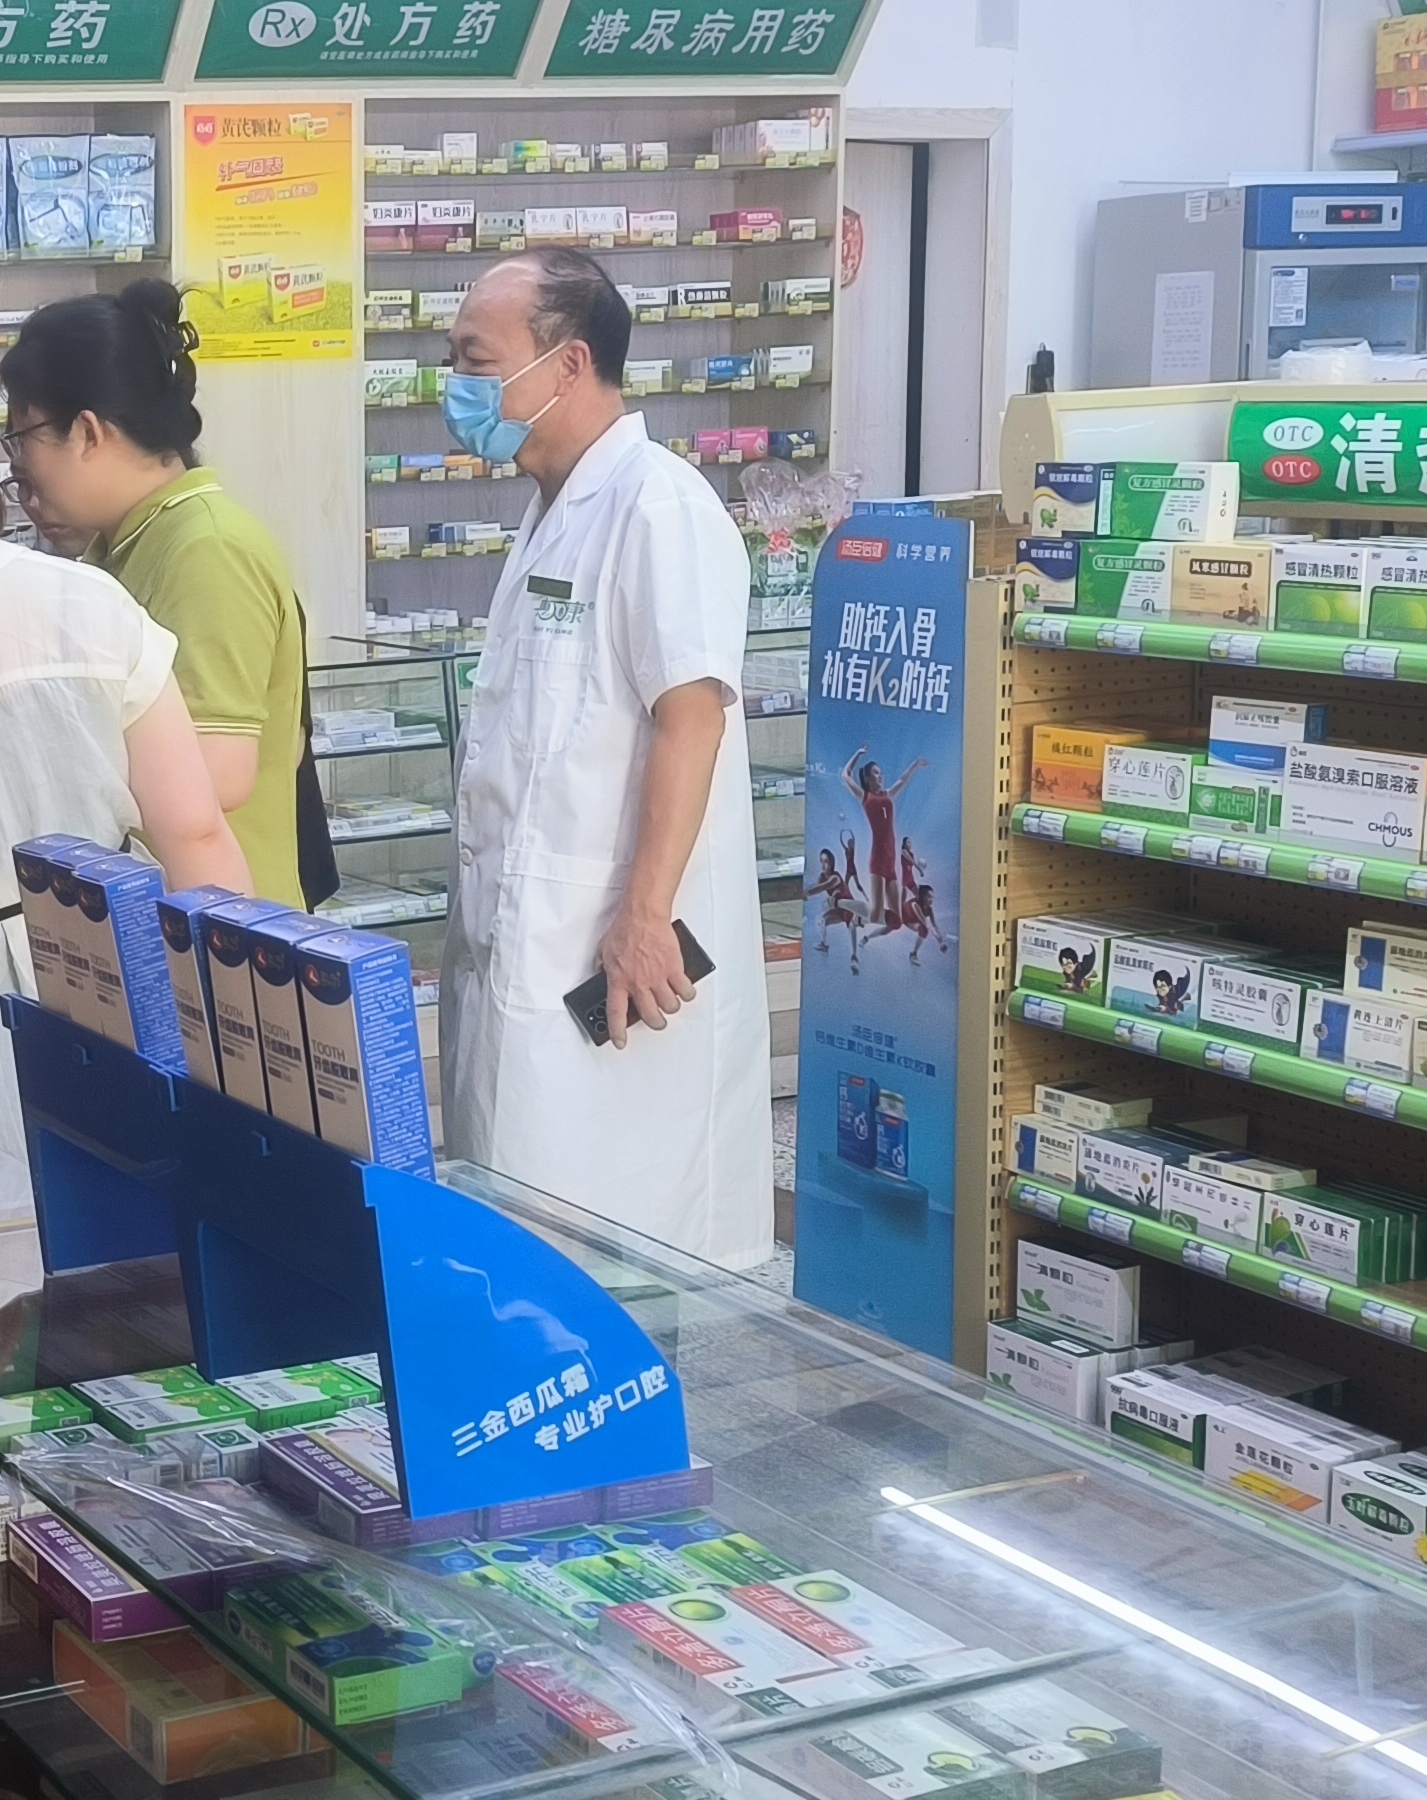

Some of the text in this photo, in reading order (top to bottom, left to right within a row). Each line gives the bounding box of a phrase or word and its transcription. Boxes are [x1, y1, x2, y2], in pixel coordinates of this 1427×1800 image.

[259, 2, 501, 47] Rx 处方药
[578, 7, 836, 56] 糖尿病用药
[221, 116, 283, 138] 黄芪颗粒
[373, 206, 414, 220] 妇炎康片
[431, 205, 473, 219] 妇炎康片
[1273, 424, 1315, 443] OTC
[1329, 411, 1427, 497] 清
[1271, 460, 1313, 479] OTC
[1131, 476, 1204, 490] 复方感冒灵颗粒
[895, 543, 952, 562] 科学营养
[1096, 557, 1164, 571] 复方感冒灵颗粒
[1190, 560, 1251, 575] 风寒感冒颗粒
[1285, 562, 1359, 580] 感冒清热颗粒
[838, 602, 936, 658] 助钙入骨
[1108, 756, 1166, 779] 穿心莲片
[1289, 761, 1419, 795] 盐酸氨溴索口服溶液
[1367, 822, 1413, 838] CHMOUS
[1211, 977, 1268, 1001] 咳特灵胶囊
[311, 1038, 346, 1062] TOOTH
[1294, 1213, 1350, 1242] 穿心莲片
[451, 1363, 590, 1457] 三金西瓜霜
[534, 1364, 670, 1452] 专业护口腔
[1118, 1397, 1180, 1433] 抗病毒口服液
[1235, 1442, 1294, 1476] 金莲花颗粒
[747, 1587, 867, 1649] 多潘立酮片
[621, 1607, 737, 1670] 多潘立酮片
